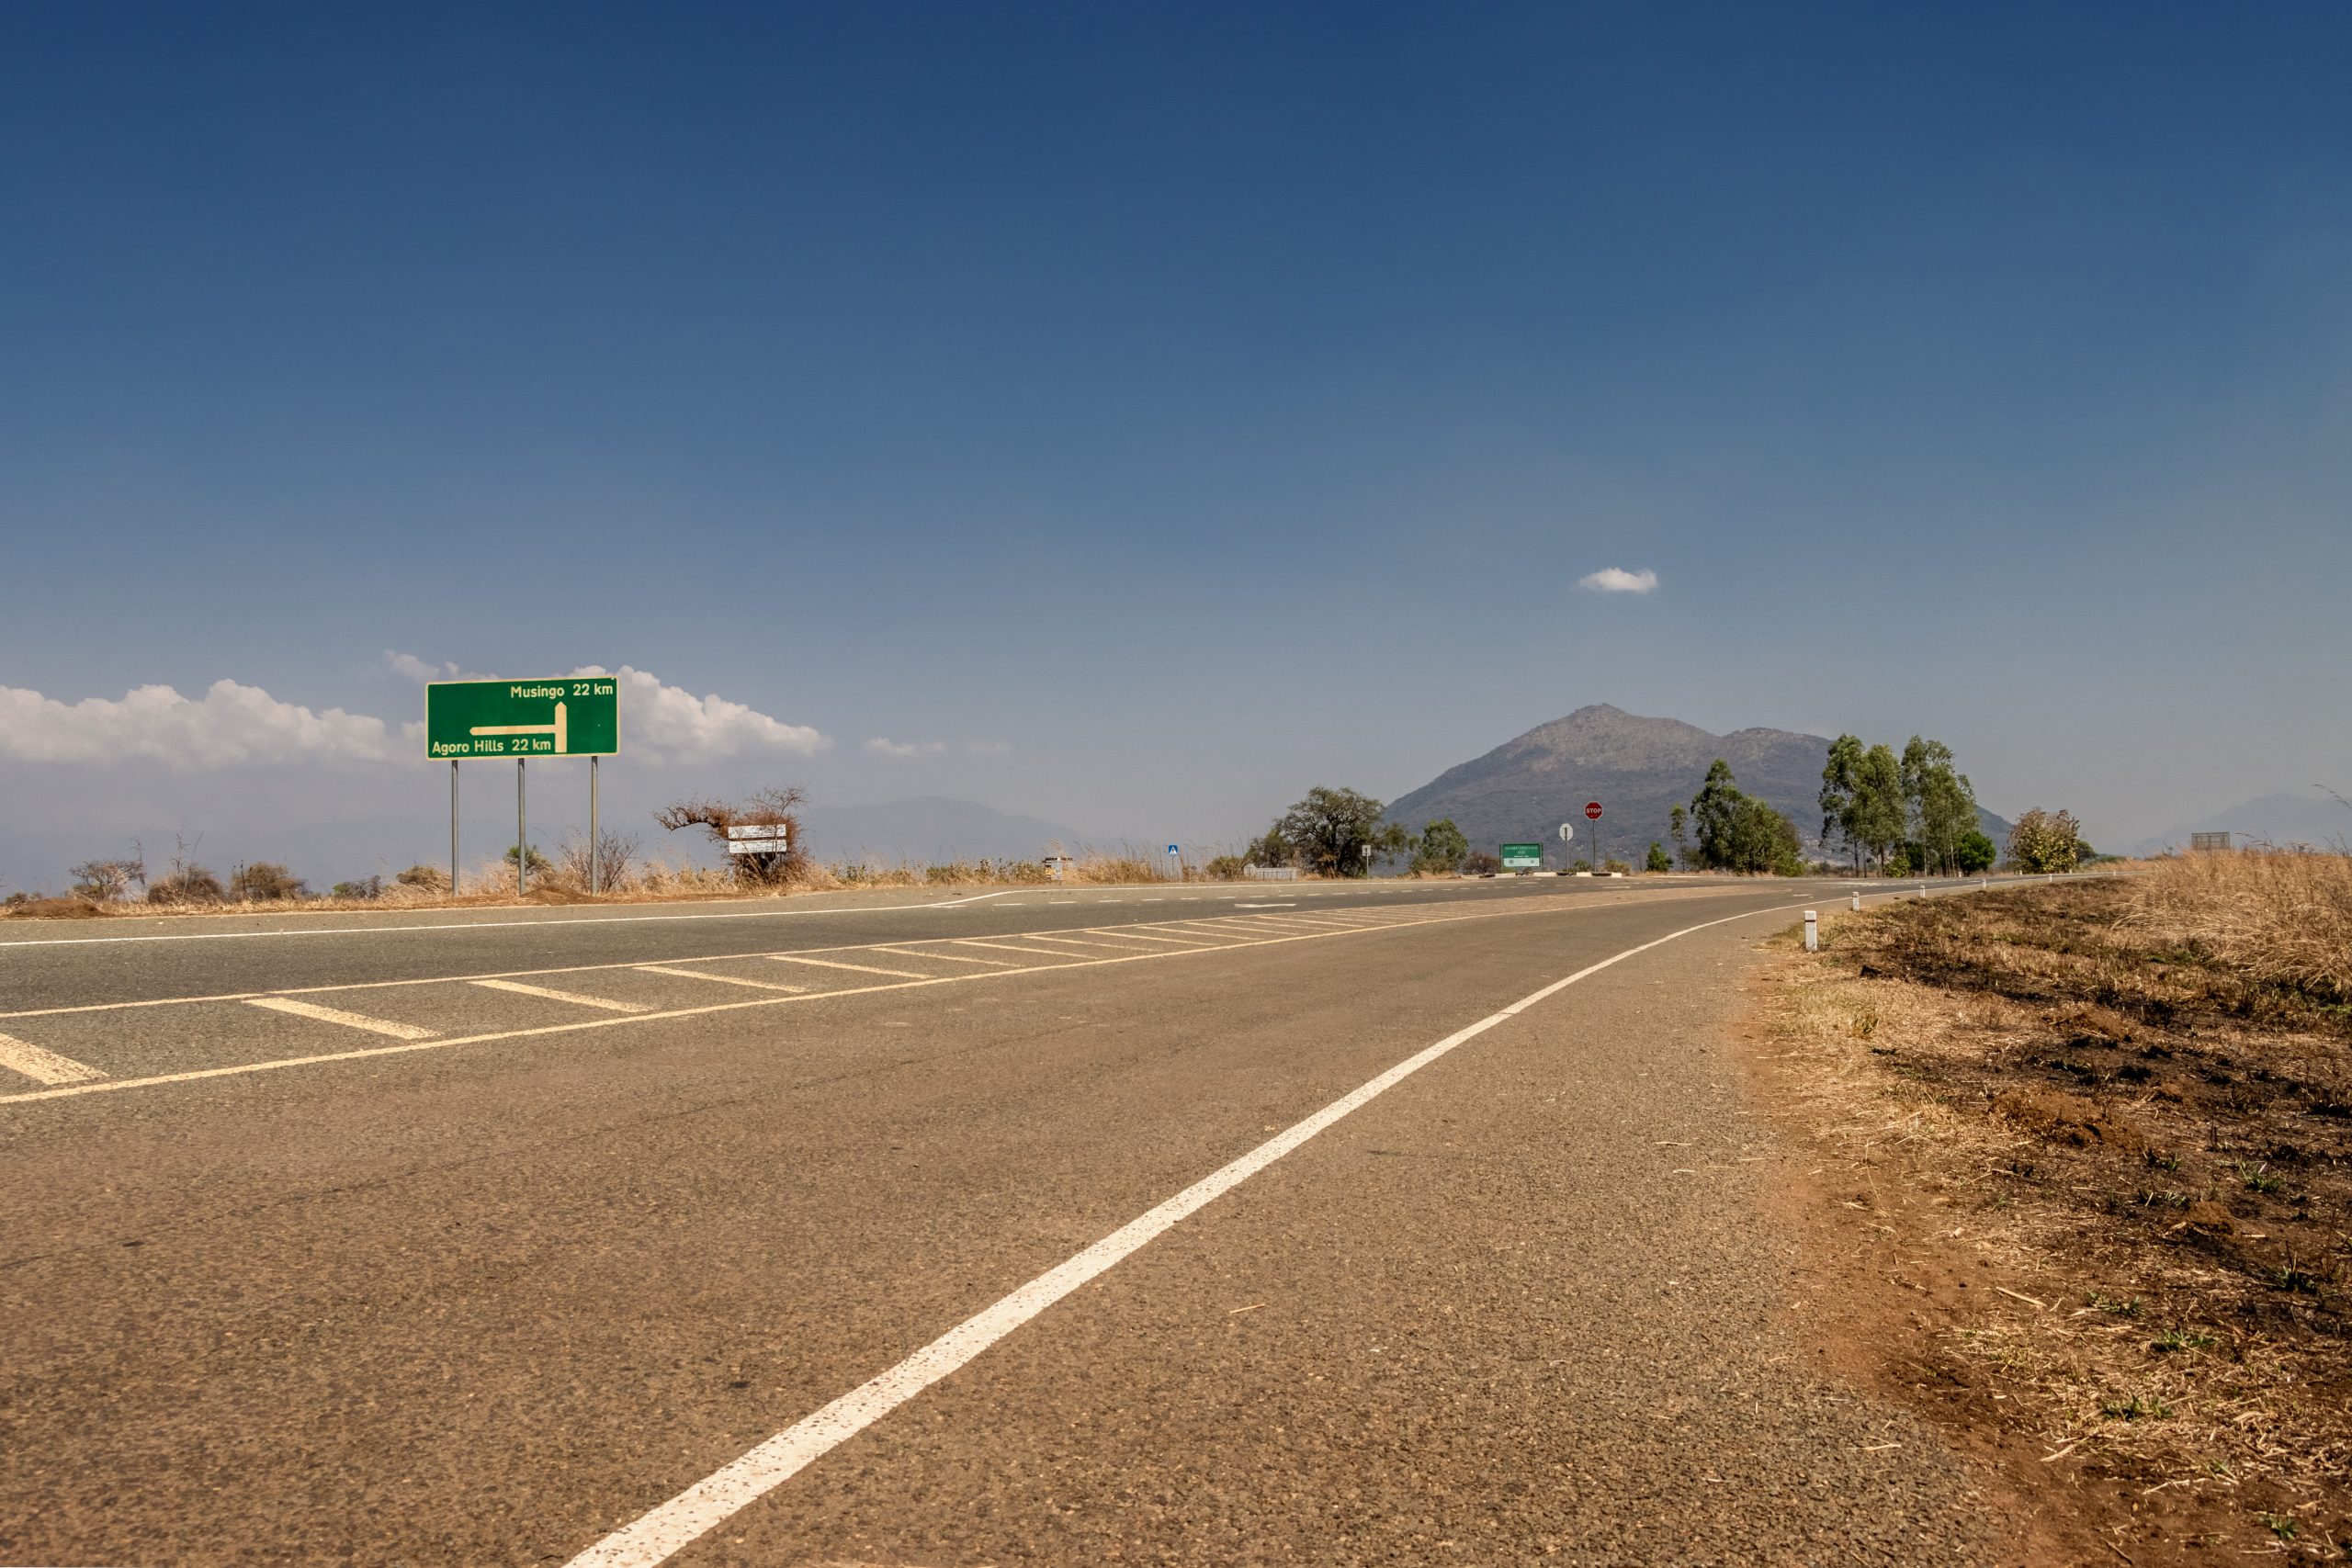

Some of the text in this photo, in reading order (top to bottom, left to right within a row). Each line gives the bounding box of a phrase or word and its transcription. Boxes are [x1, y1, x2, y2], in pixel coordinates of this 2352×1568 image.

[511, 683, 614, 699] Musingo 22 km
[432, 739, 551, 756] Agoro Hills 22 km
